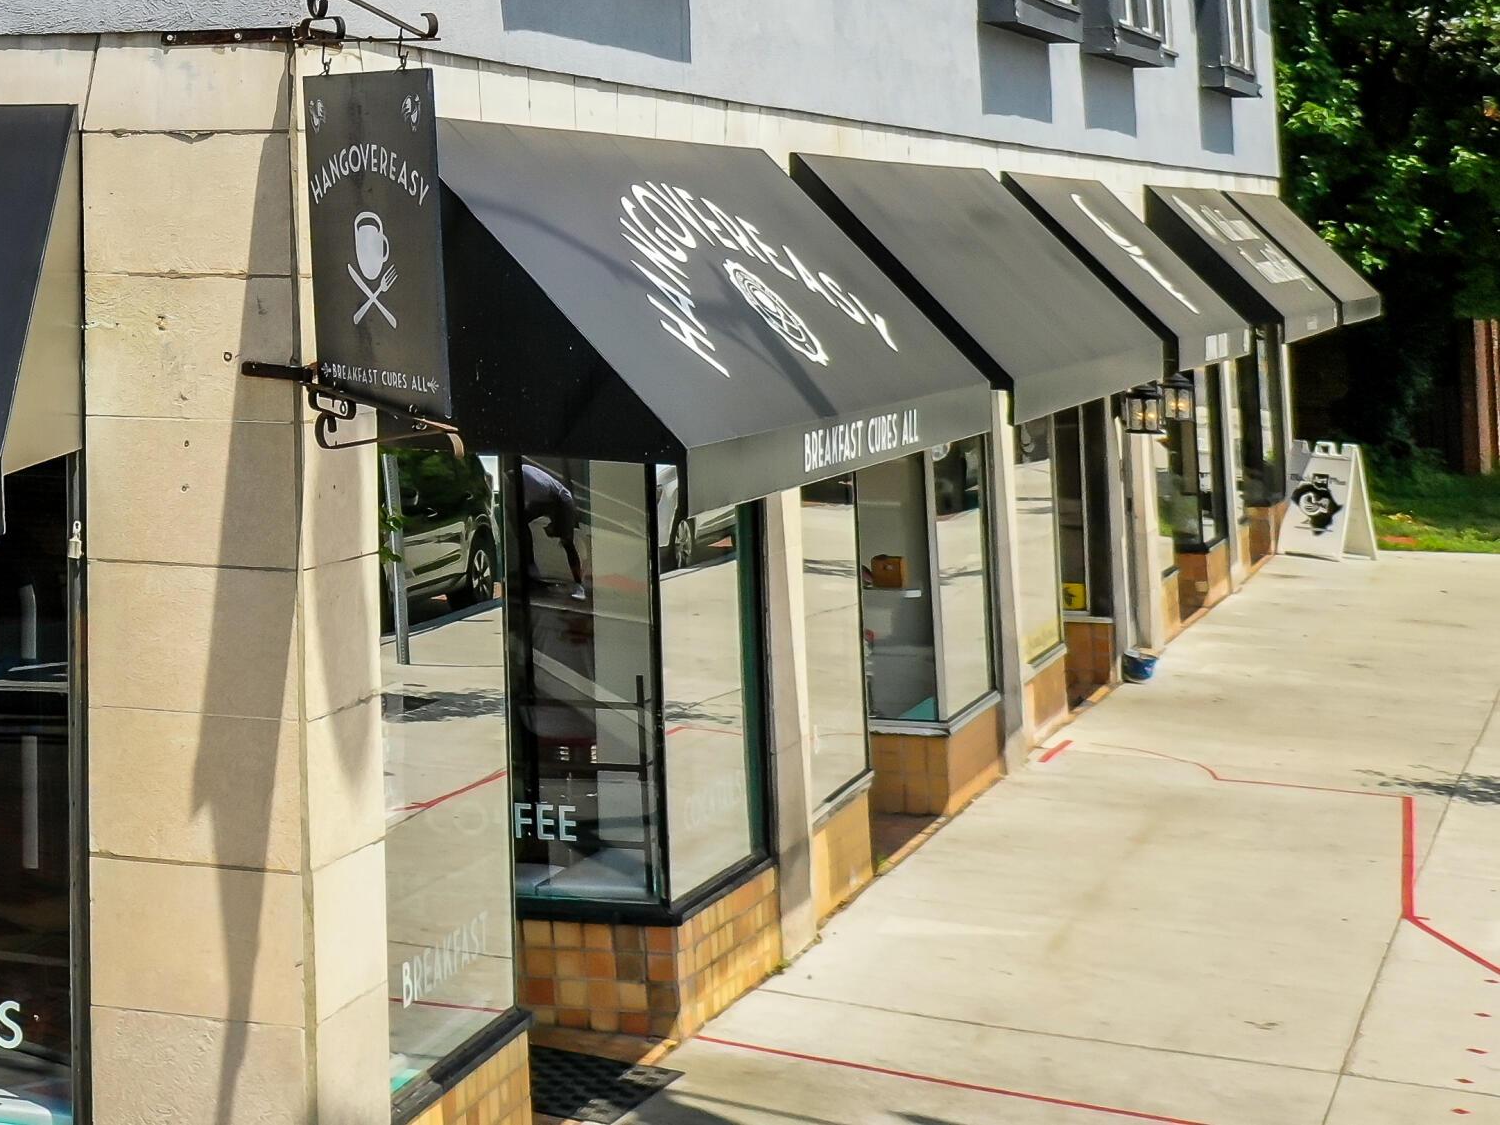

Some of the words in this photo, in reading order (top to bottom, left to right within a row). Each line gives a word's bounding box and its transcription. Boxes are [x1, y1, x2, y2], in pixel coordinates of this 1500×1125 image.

[310, 143, 430, 206] HANGOVEREASY
[619, 180, 899, 378] HANGOVEREASY
[332, 363, 378, 385] BREAKFAST
[381, 370, 407, 389] CURES
[411, 375, 428, 393] ALL
[804, 419, 864, 473] BREAKFAST
[867, 412, 898, 454] CURES
[901, 408, 920, 446] ALL
[402, 911, 488, 1009] BREAKFAST
